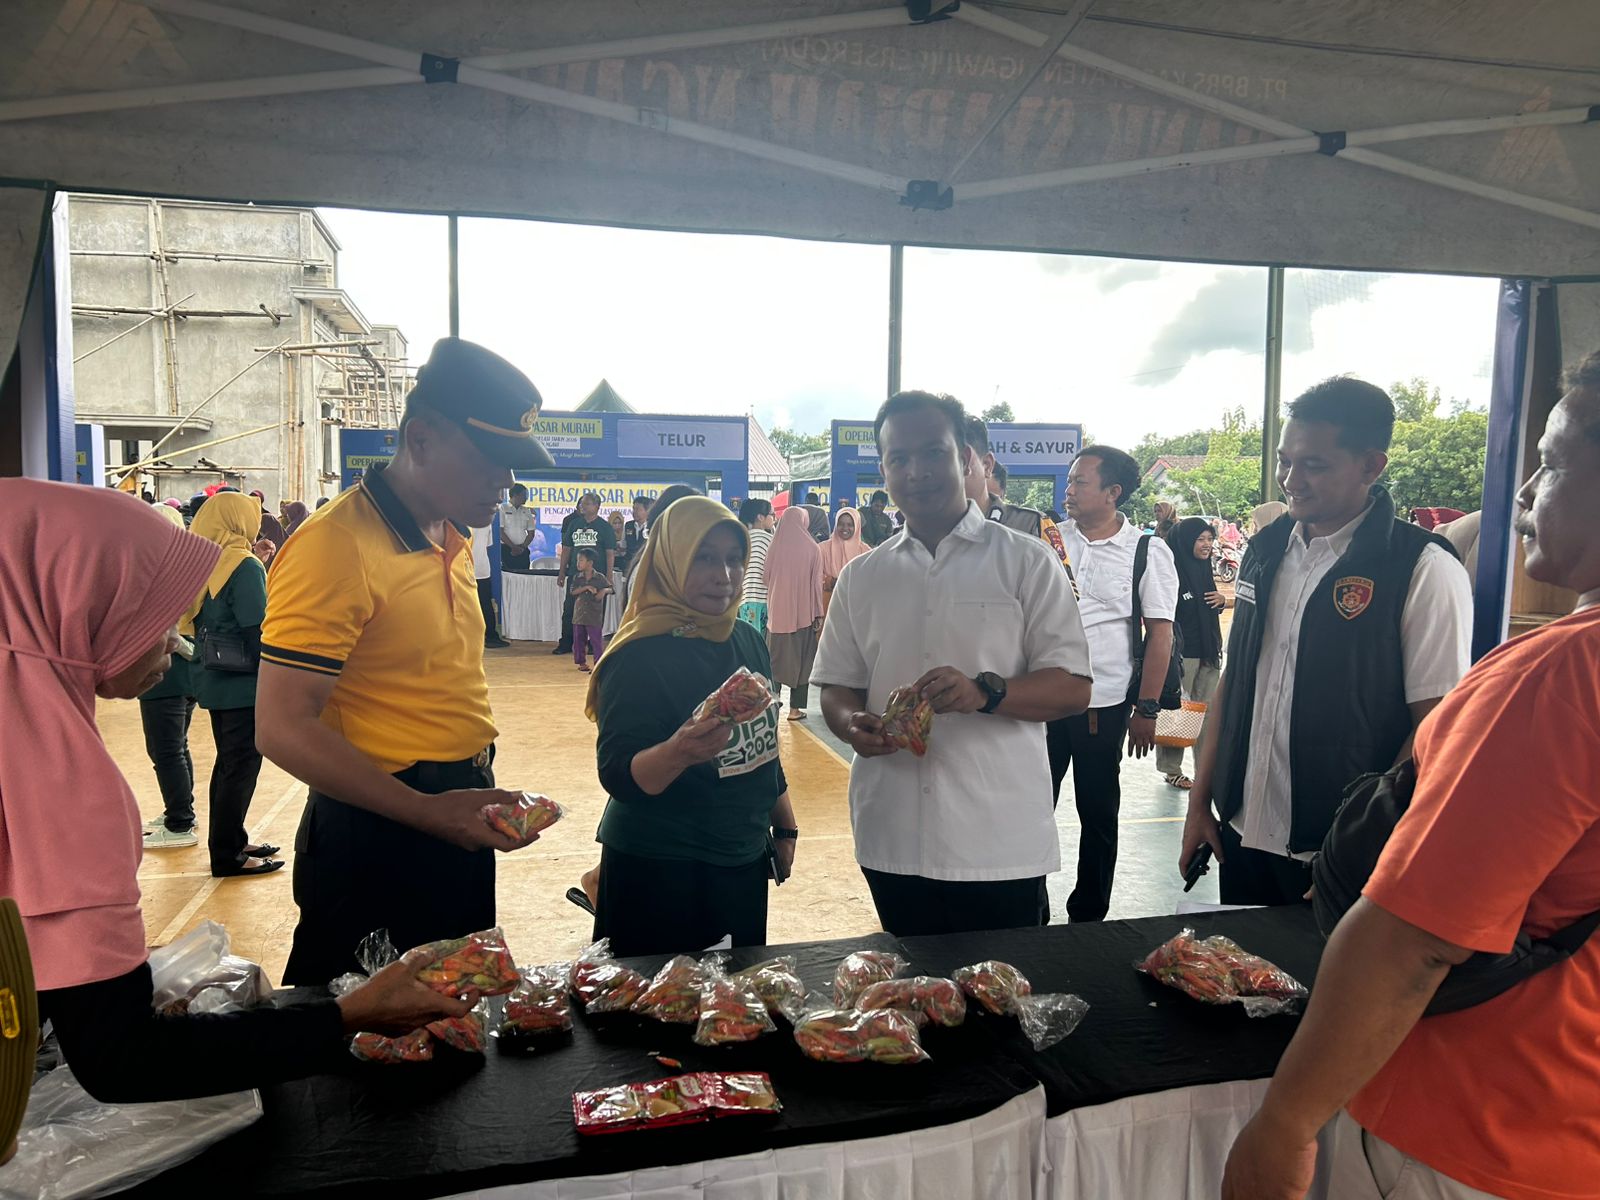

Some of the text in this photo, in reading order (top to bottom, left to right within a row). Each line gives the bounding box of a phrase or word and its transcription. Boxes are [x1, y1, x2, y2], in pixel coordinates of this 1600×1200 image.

[561, 422, 596, 434] MURAH
[657, 433, 706, 447] TELUR
[845, 430, 875, 441] OPERA
[988, 442, 1075, 454] AH & SAYUR
[529, 486, 579, 503] PERASI
